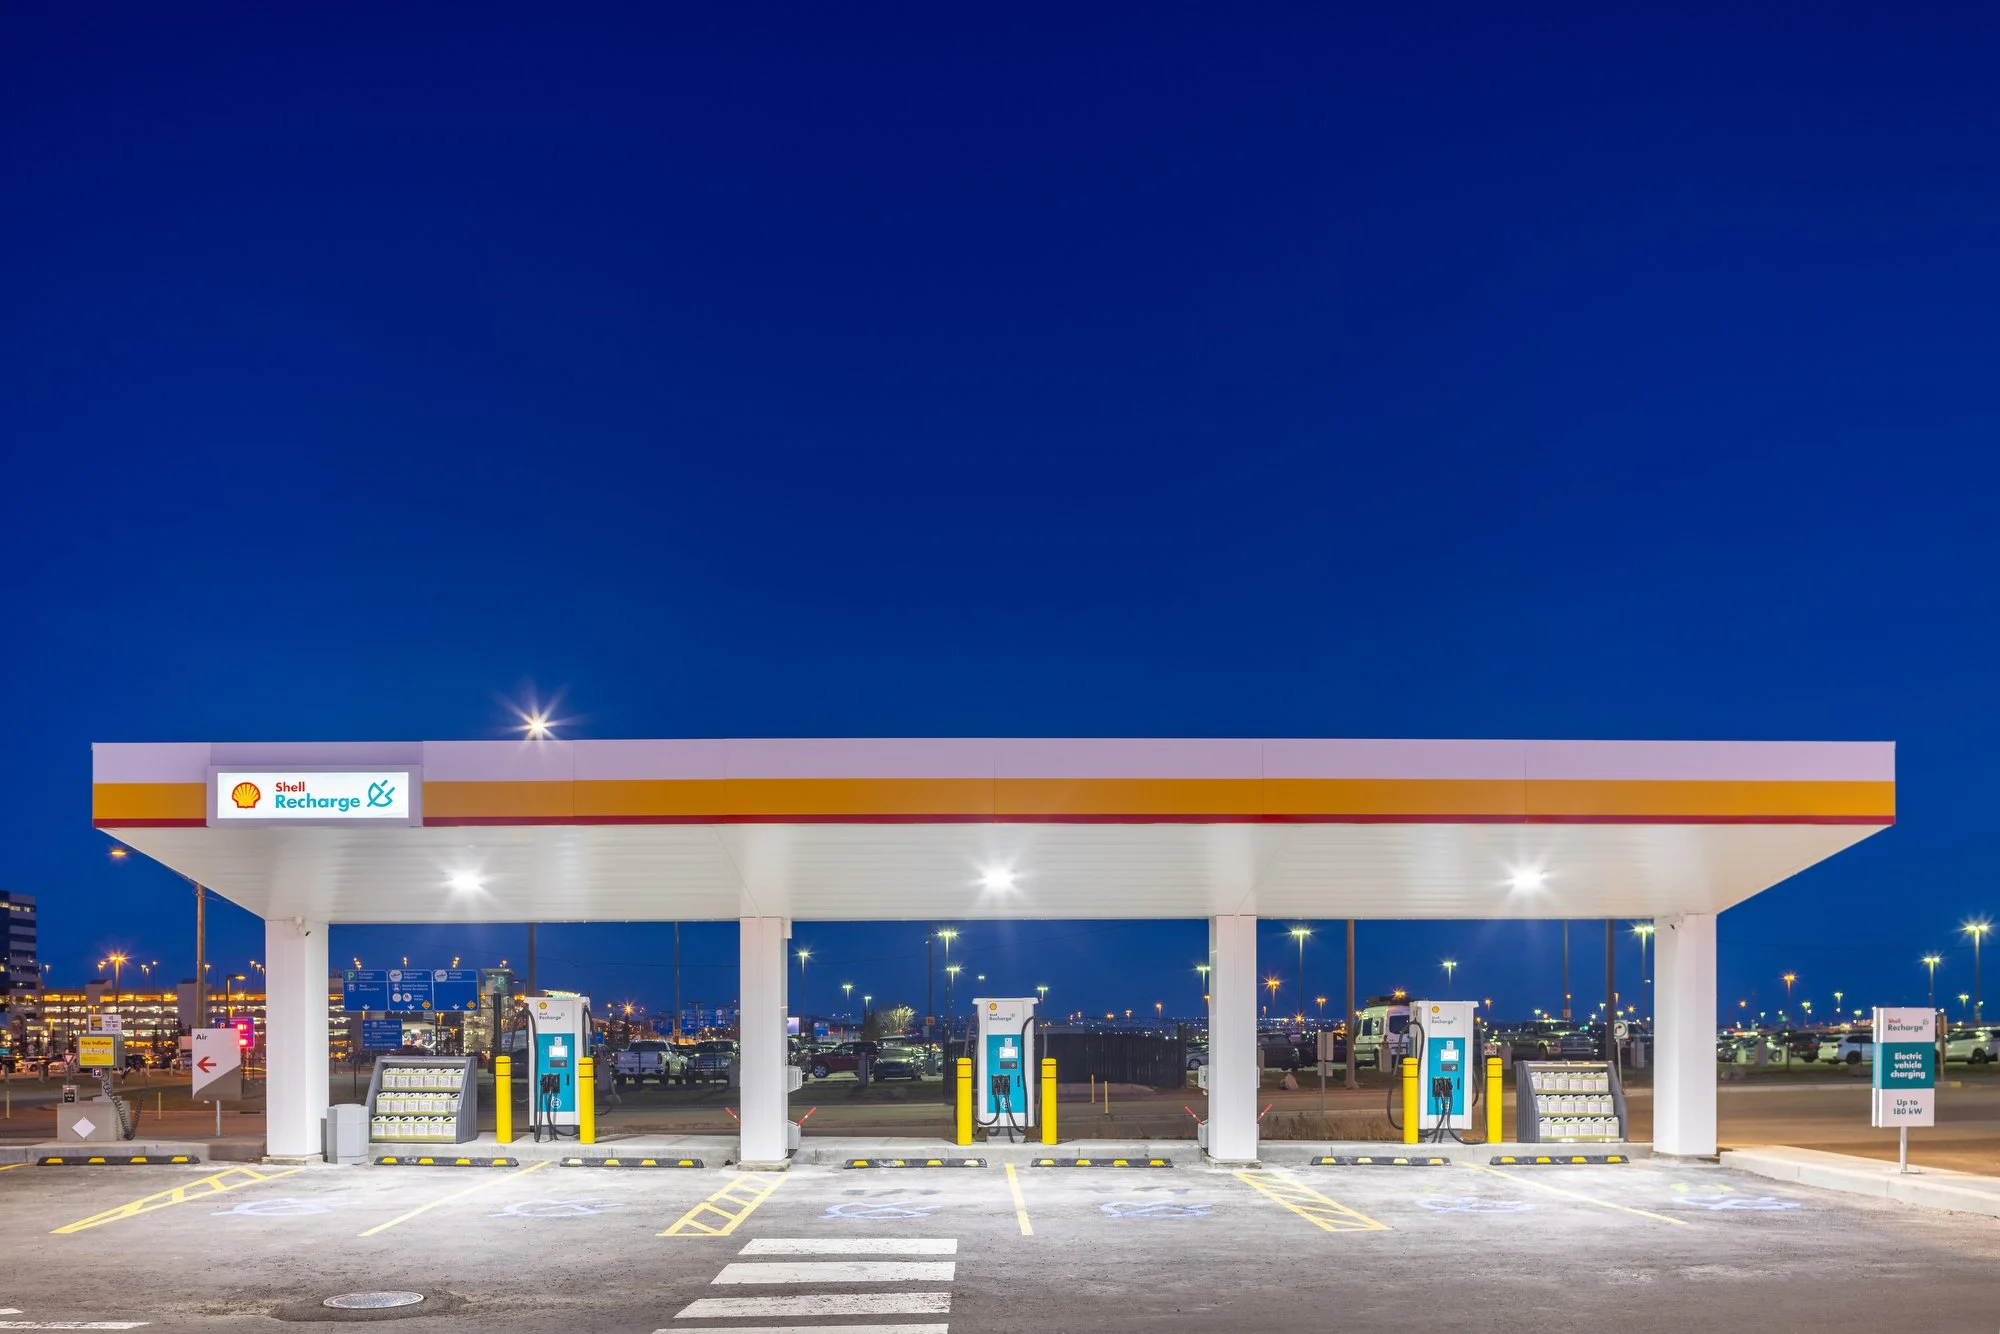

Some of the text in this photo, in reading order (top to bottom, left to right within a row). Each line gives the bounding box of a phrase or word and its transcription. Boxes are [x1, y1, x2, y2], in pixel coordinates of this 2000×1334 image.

[276, 782, 306, 792] Shell
[275, 793, 360, 812] Recharge
[1887, 1024, 1924, 1032] Recharge
[1890, 1070, 1926, 1079] charging
